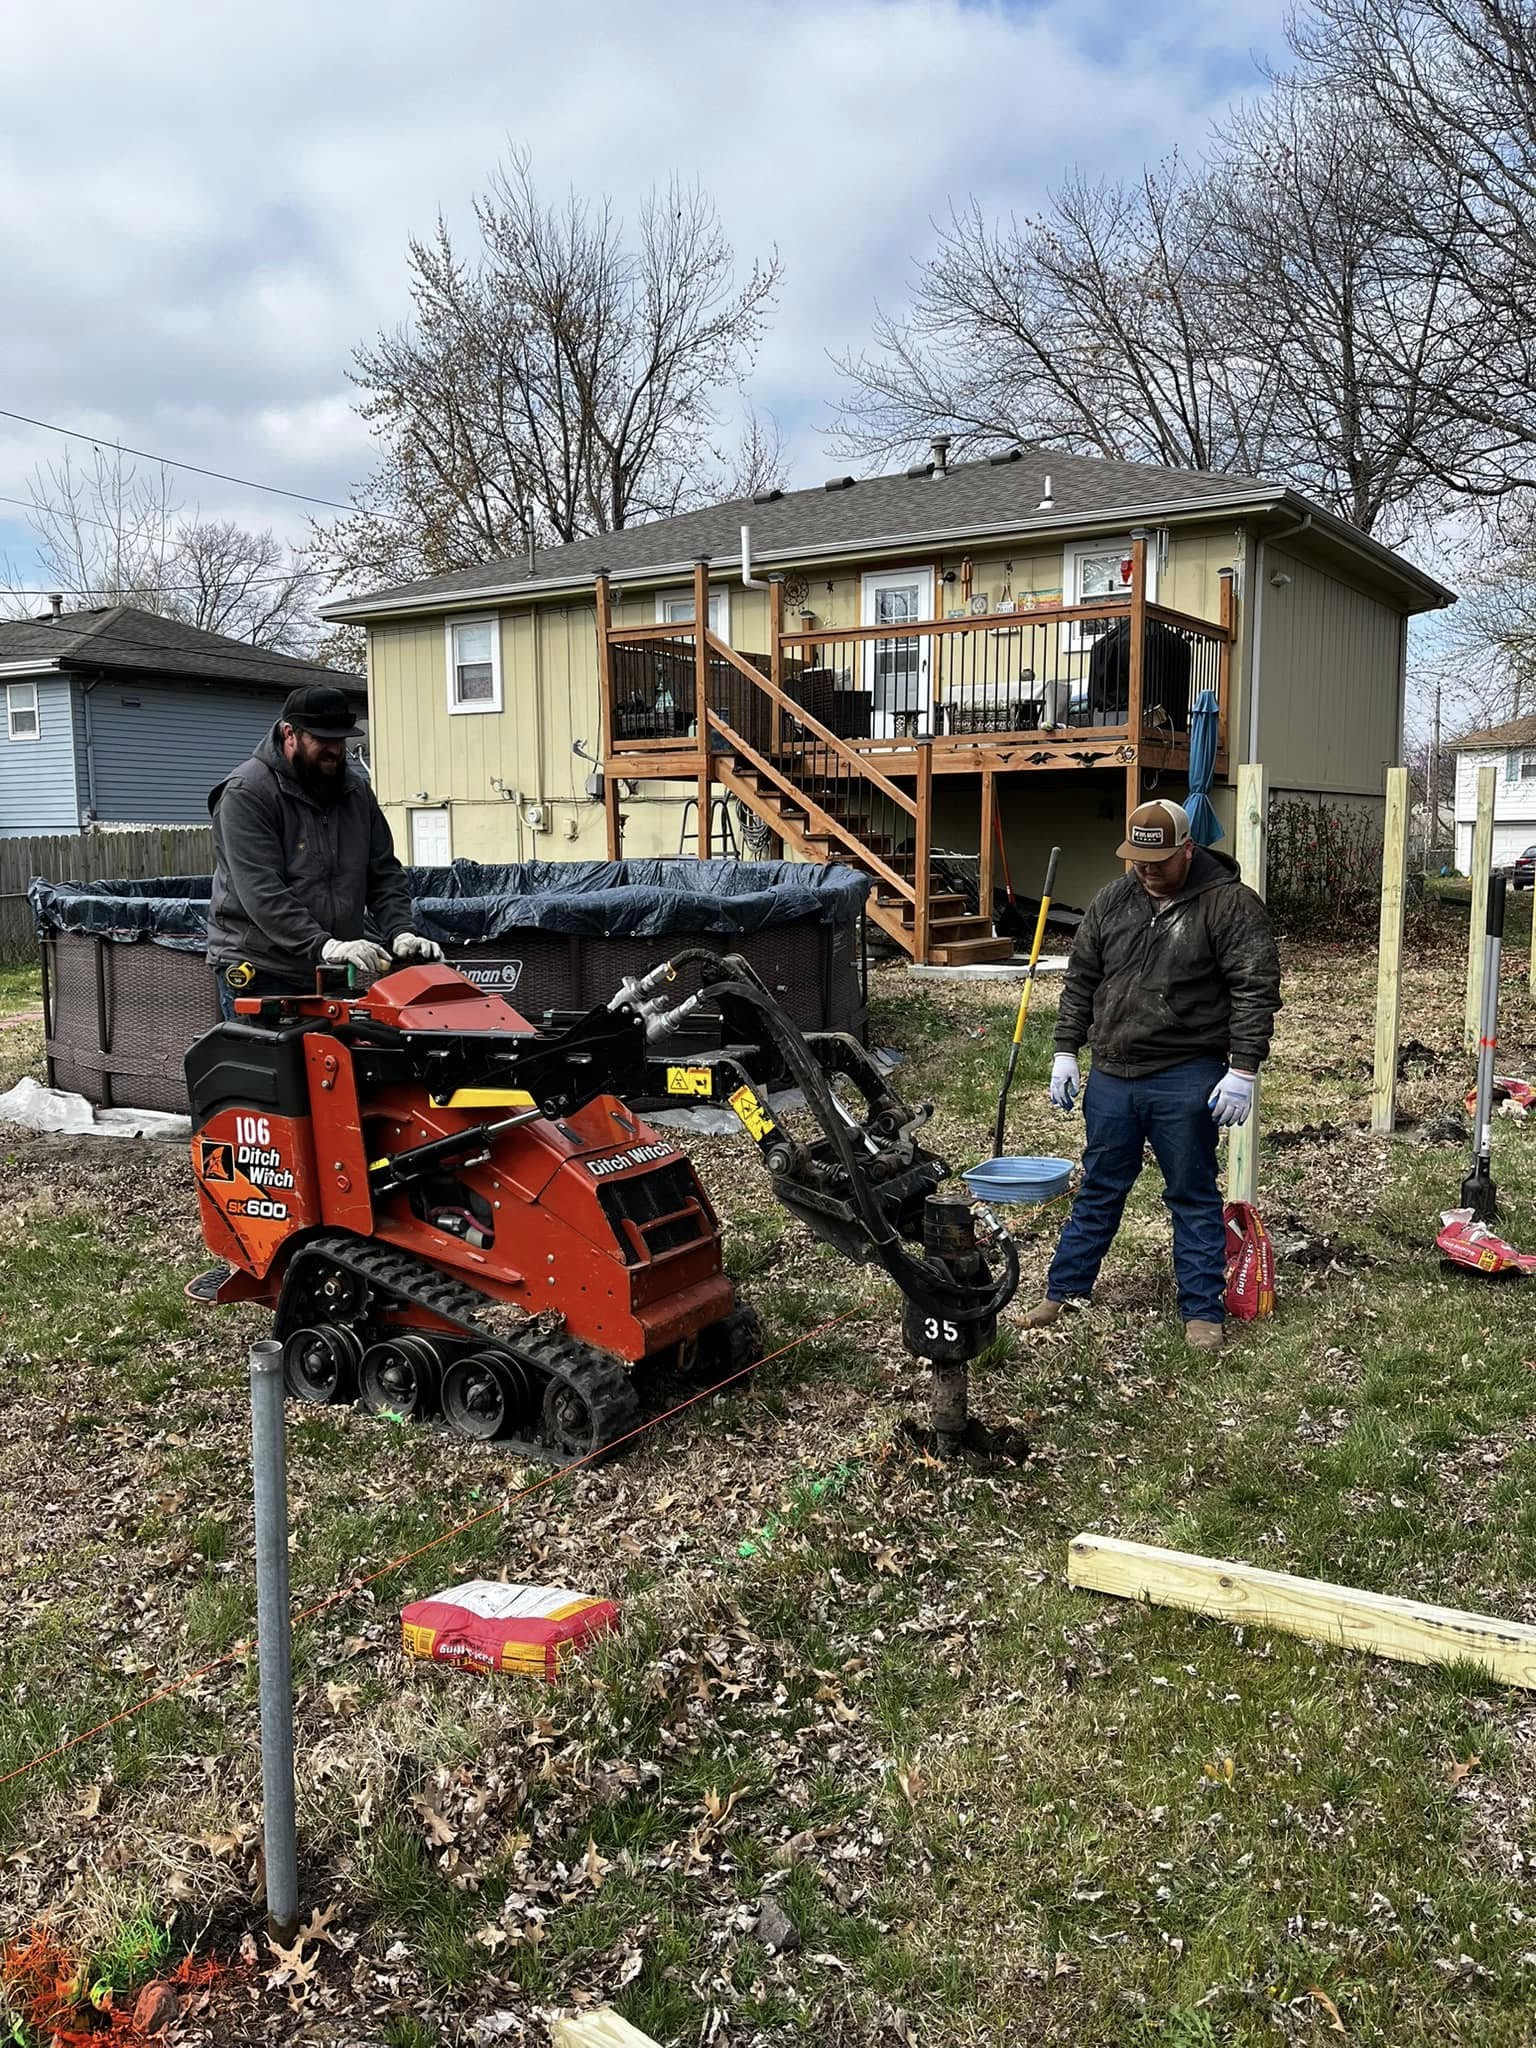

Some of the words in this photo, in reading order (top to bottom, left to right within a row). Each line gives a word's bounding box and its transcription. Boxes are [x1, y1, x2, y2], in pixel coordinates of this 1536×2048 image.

[236, 1117, 270, 1145] 106
[238, 1146, 280, 1167] Ditch
[586, 1154, 632, 1176] Ditch
[627, 1141, 675, 1164] Witch
[249, 1167, 294, 1188] Witch
[228, 1200, 287, 1219] SK600
[924, 1317, 958, 1342] 35
[404, 1638, 415, 1652] 50
